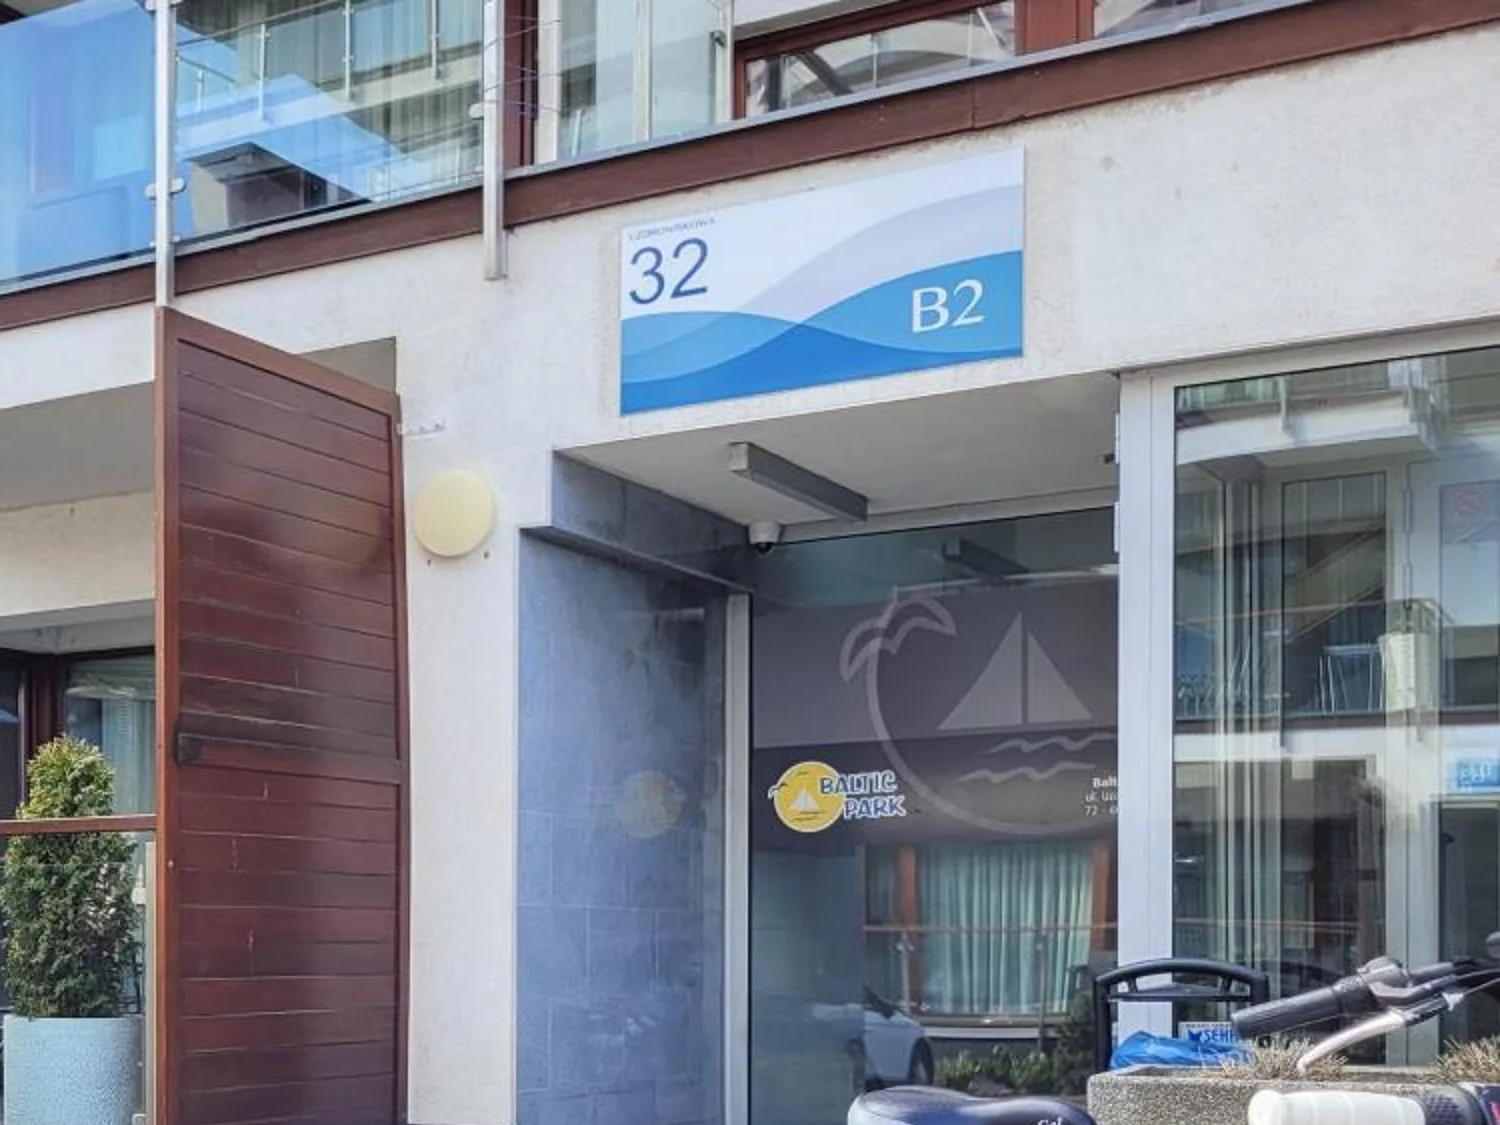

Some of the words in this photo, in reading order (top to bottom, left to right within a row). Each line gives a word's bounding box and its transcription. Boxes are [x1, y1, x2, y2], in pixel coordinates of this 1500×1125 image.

[628, 238, 708, 304] 32
[912, 279, 985, 333] B2
[818, 769, 898, 796] BALTIC
[843, 795, 907, 819] PARK
